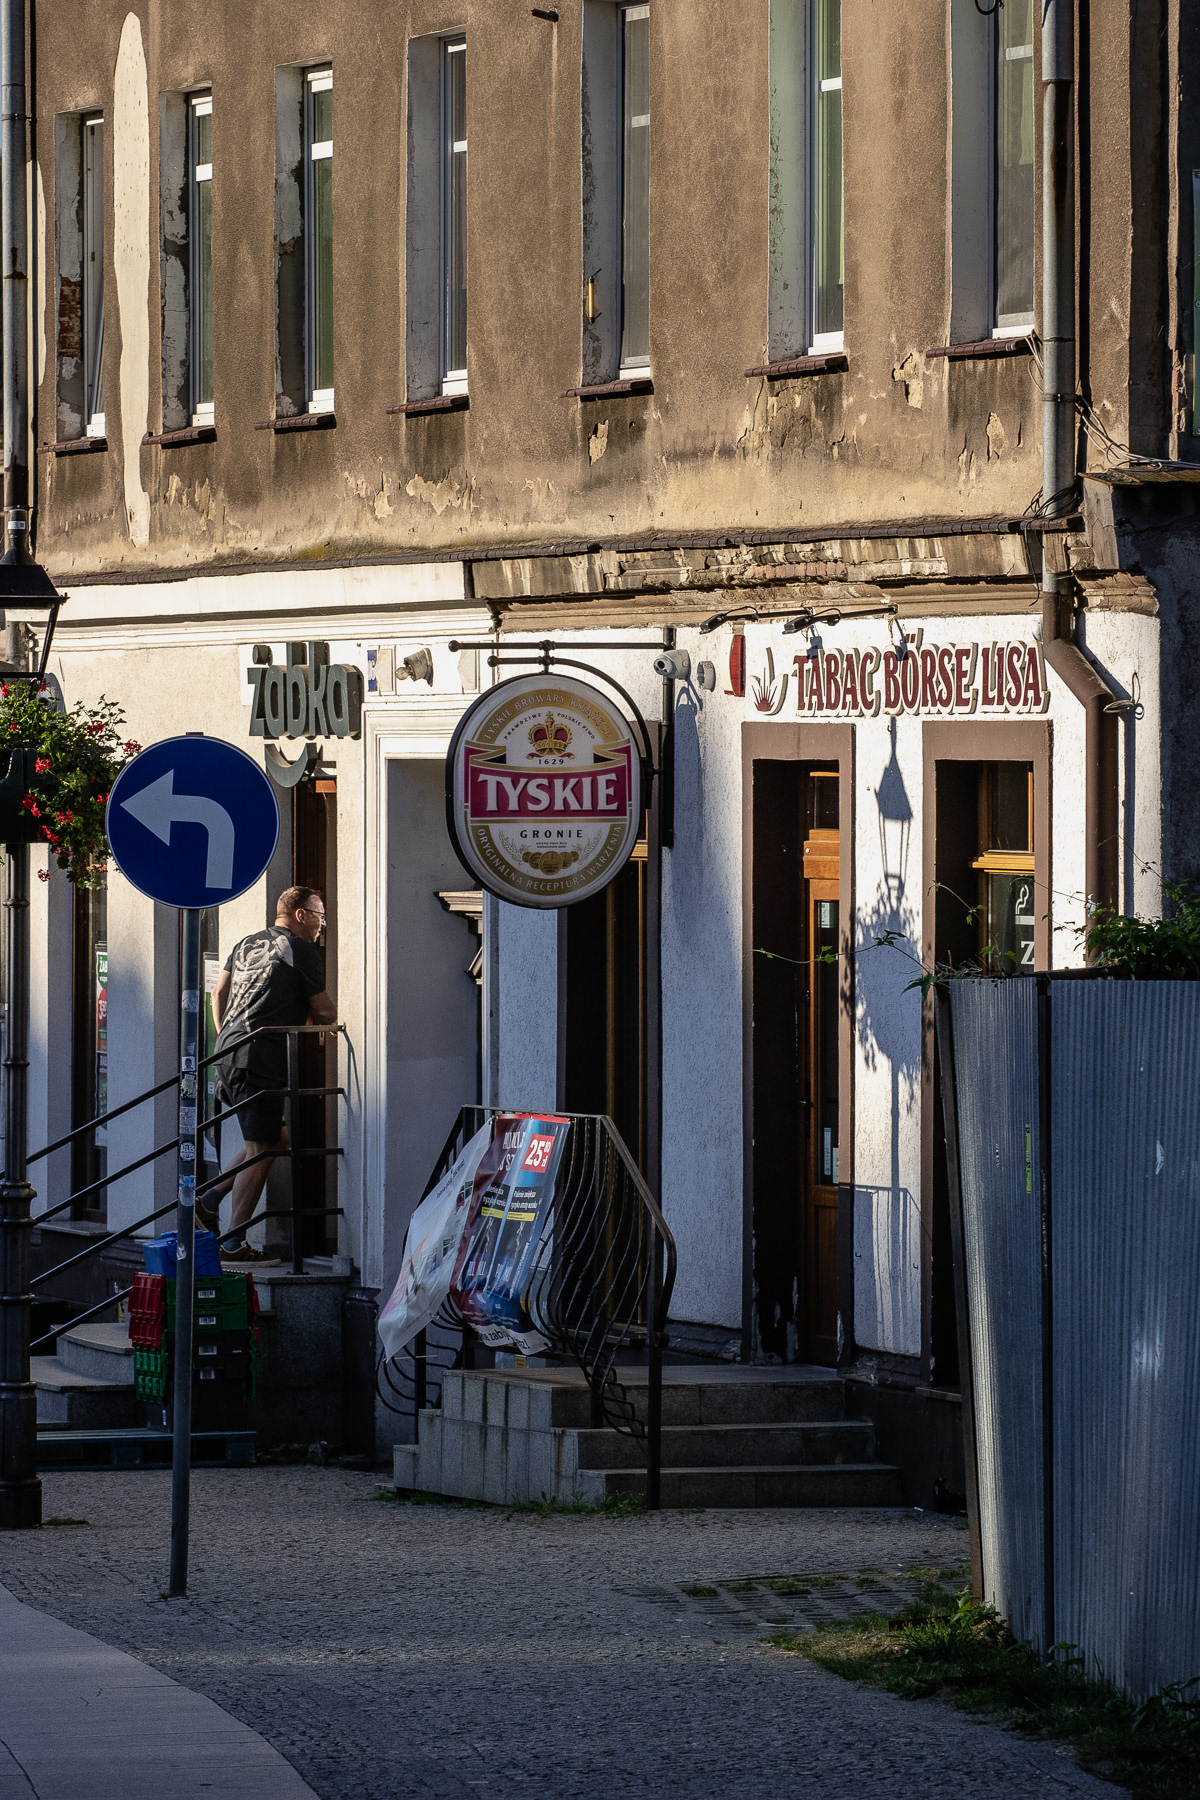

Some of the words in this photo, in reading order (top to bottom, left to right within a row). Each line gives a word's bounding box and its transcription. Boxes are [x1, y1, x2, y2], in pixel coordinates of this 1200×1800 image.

[247, 642, 359, 738] żabka
[793, 652, 875, 711] TABAC
[883, 634, 971, 709] BÖRSE
[981, 647, 1042, 706] LISA
[484, 708, 513, 740] TYSKIE
[514, 694, 567, 710] BROWARY
[570, 698, 613, 738] KSIĄŻĘCE
[503, 713, 542, 740] PRAWDZIWE
[556, 712, 582, 727] POLSKIE
[581, 725, 596, 741] PIWO
[477, 773, 619, 813] TYSKIE
[520, 829, 584, 839] GRONIE
[477, 828, 523, 885] ORYGINALNA
[525, 874, 587, 891] RECEPTURA
[586, 826, 622, 876] WARZENIA
[524, 1139, 546, 1167] 25
